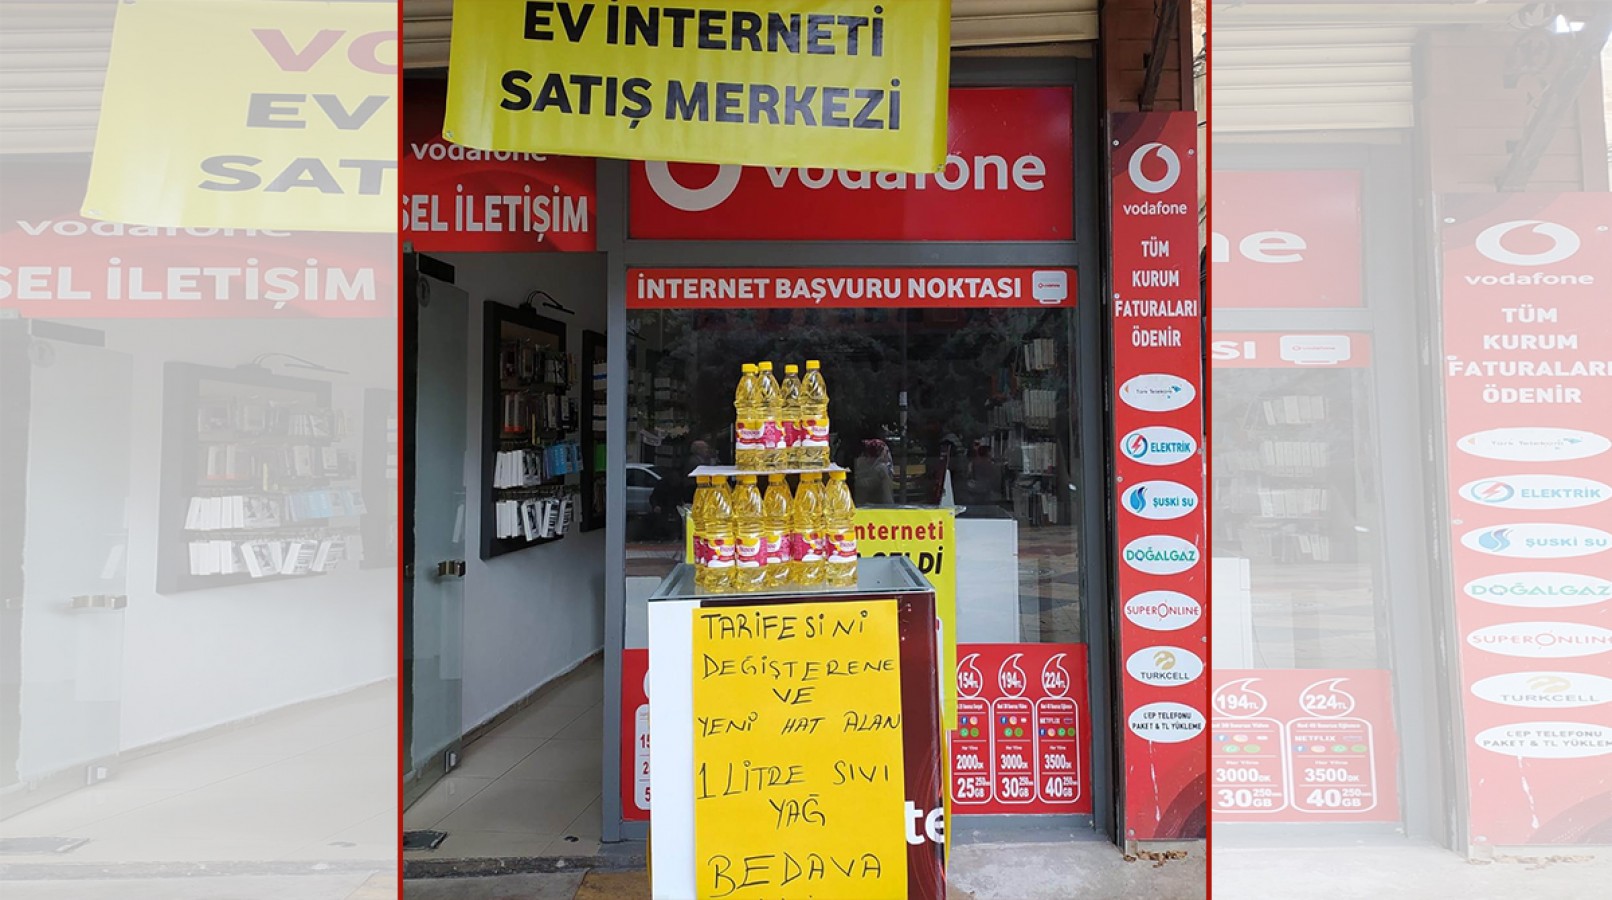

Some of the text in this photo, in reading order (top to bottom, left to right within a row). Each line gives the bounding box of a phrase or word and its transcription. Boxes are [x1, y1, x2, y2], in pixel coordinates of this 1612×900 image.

[523, 0, 885, 58] EV İNTERNETİ
[500, 69, 901, 131] SATIŞ MERKEZİ
[246, 93, 390, 130] EV
[455, 183, 588, 243] İLETİŞİM
[1123, 201, 1188, 215] vodafone
[1141, 236, 1169, 257] TÜM
[107, 257, 376, 310] İLETİŞİM
[1132, 269, 1179, 287] KURUM
[1464, 272, 1594, 286] vodafone
[637, 273, 1021, 304] İNTERNET BAŞVURU NOKTASI
[1115, 299, 1197, 317] FATURALARI
[1501, 304, 1558, 323] TÜM
[1131, 325, 1181, 347] ÖDENİR
[1483, 334, 1578, 350] KURUM
[1482, 384, 1583, 404] ÖDENİR
[1150, 440, 1191, 453] ELEKTRİK
[1521, 486, 1601, 498] ELEKTRİK
[1153, 495, 1194, 509] ŞUSKİ SU
[1526, 537, 1608, 549] ŞUSKİ SU
[1126, 547, 1195, 563] DOĞALGAZ
[1471, 582, 1612, 596] DOĞALGAZ
[1127, 602, 1200, 618] SUPERONLINE
[702, 653, 895, 681] DEĞİŞTERENE
[1140, 671, 1190, 680] TURKCELL
[772, 686, 815, 705] VE
[1500, 694, 1600, 702] TURKCELL
[698, 711, 901, 737] YENİ HAT ALAN
[1158, 711, 1192, 720] TELEFONU
[1132, 722, 1154, 730] PAKET
[1171, 721, 1202, 730] YÜKLEME
[1536, 730, 1603, 738] TELEFONU
[1483, 739, 1524, 747] PAKET
[1544, 739, 1558, 747] TL
[723, 760, 806, 796] LİTRE
[833, 760, 890, 785] SIVI
[769, 793, 826, 830] YAĞ
[707, 851, 882, 898] BEDAVA
